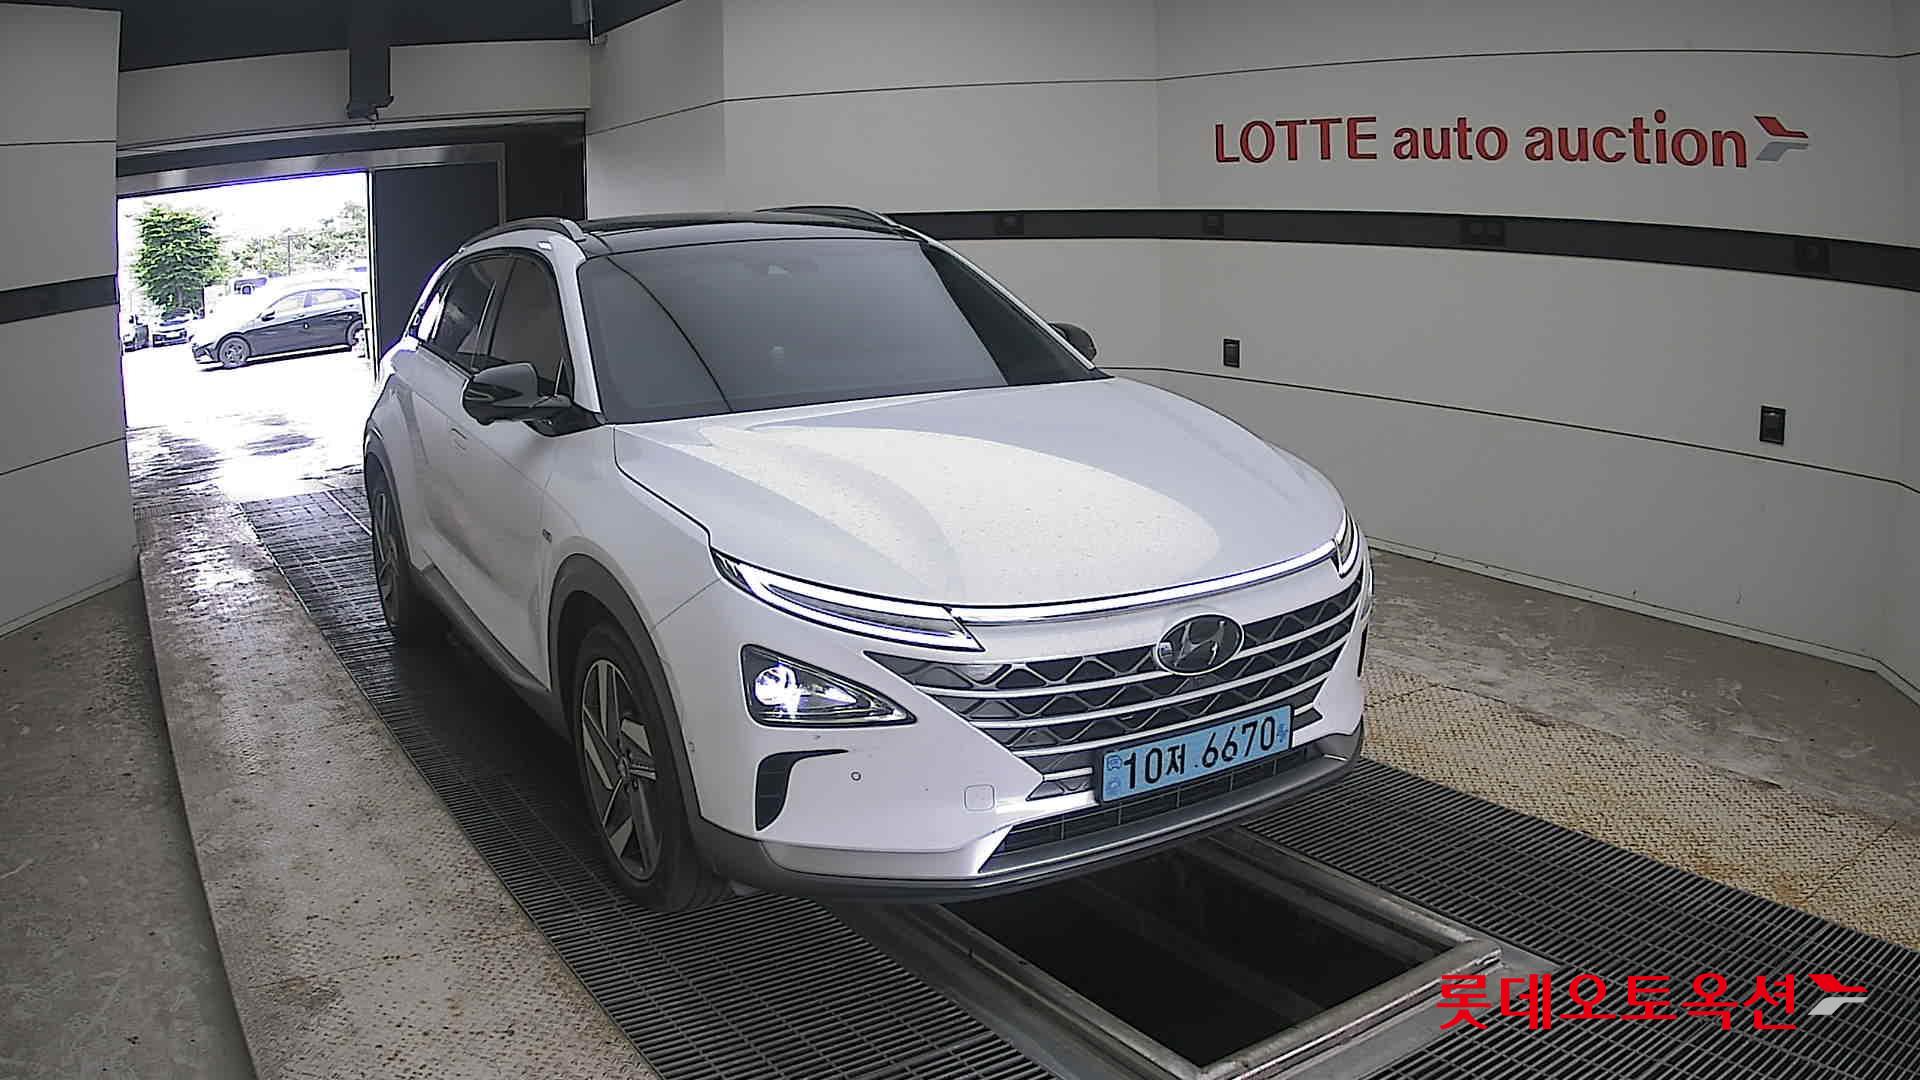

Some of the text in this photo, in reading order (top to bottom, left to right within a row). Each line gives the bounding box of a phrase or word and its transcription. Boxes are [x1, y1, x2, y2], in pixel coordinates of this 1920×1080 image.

[1215, 109, 1749, 168] LOTTE auto auction
[1201, 716, 1277, 768] 6670
